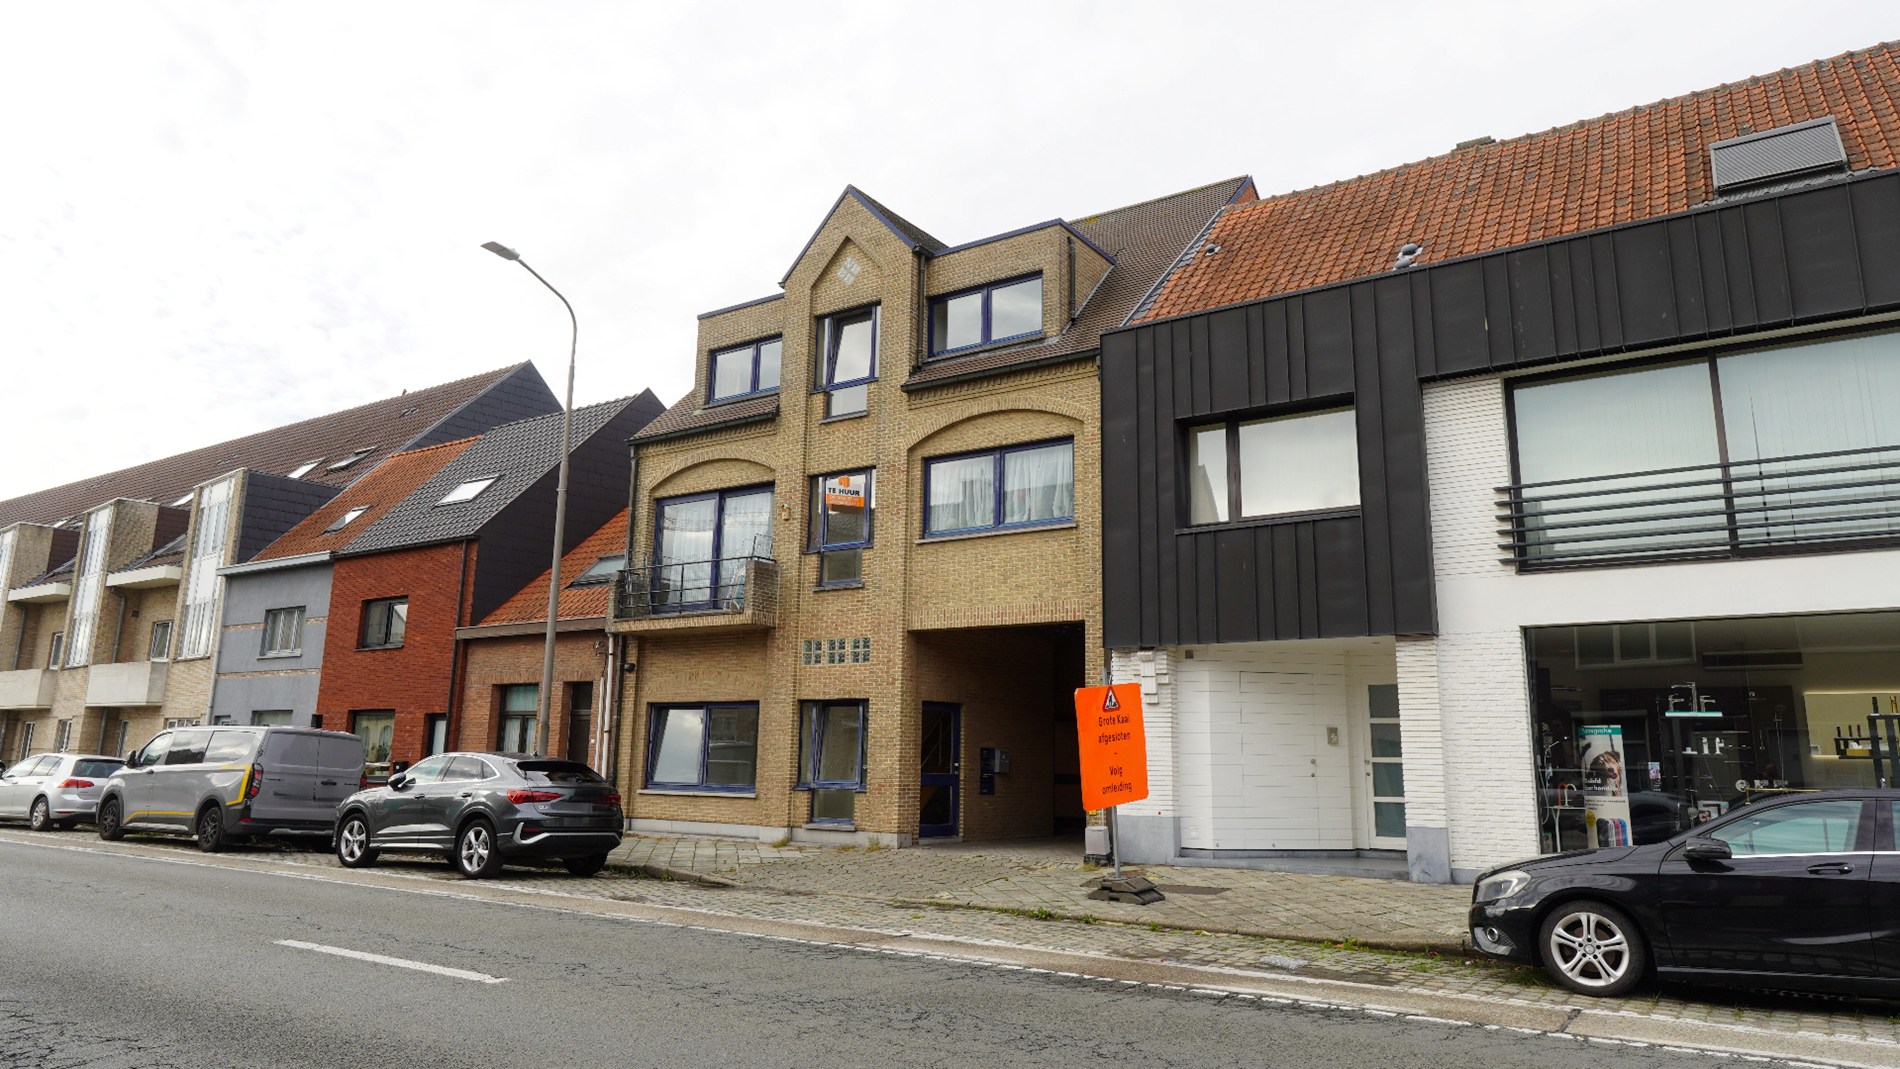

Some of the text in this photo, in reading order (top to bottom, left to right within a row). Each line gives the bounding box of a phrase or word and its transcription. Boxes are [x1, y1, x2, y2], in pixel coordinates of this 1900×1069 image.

[838, 488, 860, 496] HUUR
[1098, 715, 1116, 727] Grote
[1098, 731, 1131, 746] afgesloten
[1109, 765, 1123, 777] Volg
[1102, 781, 1133, 795] omleiding
